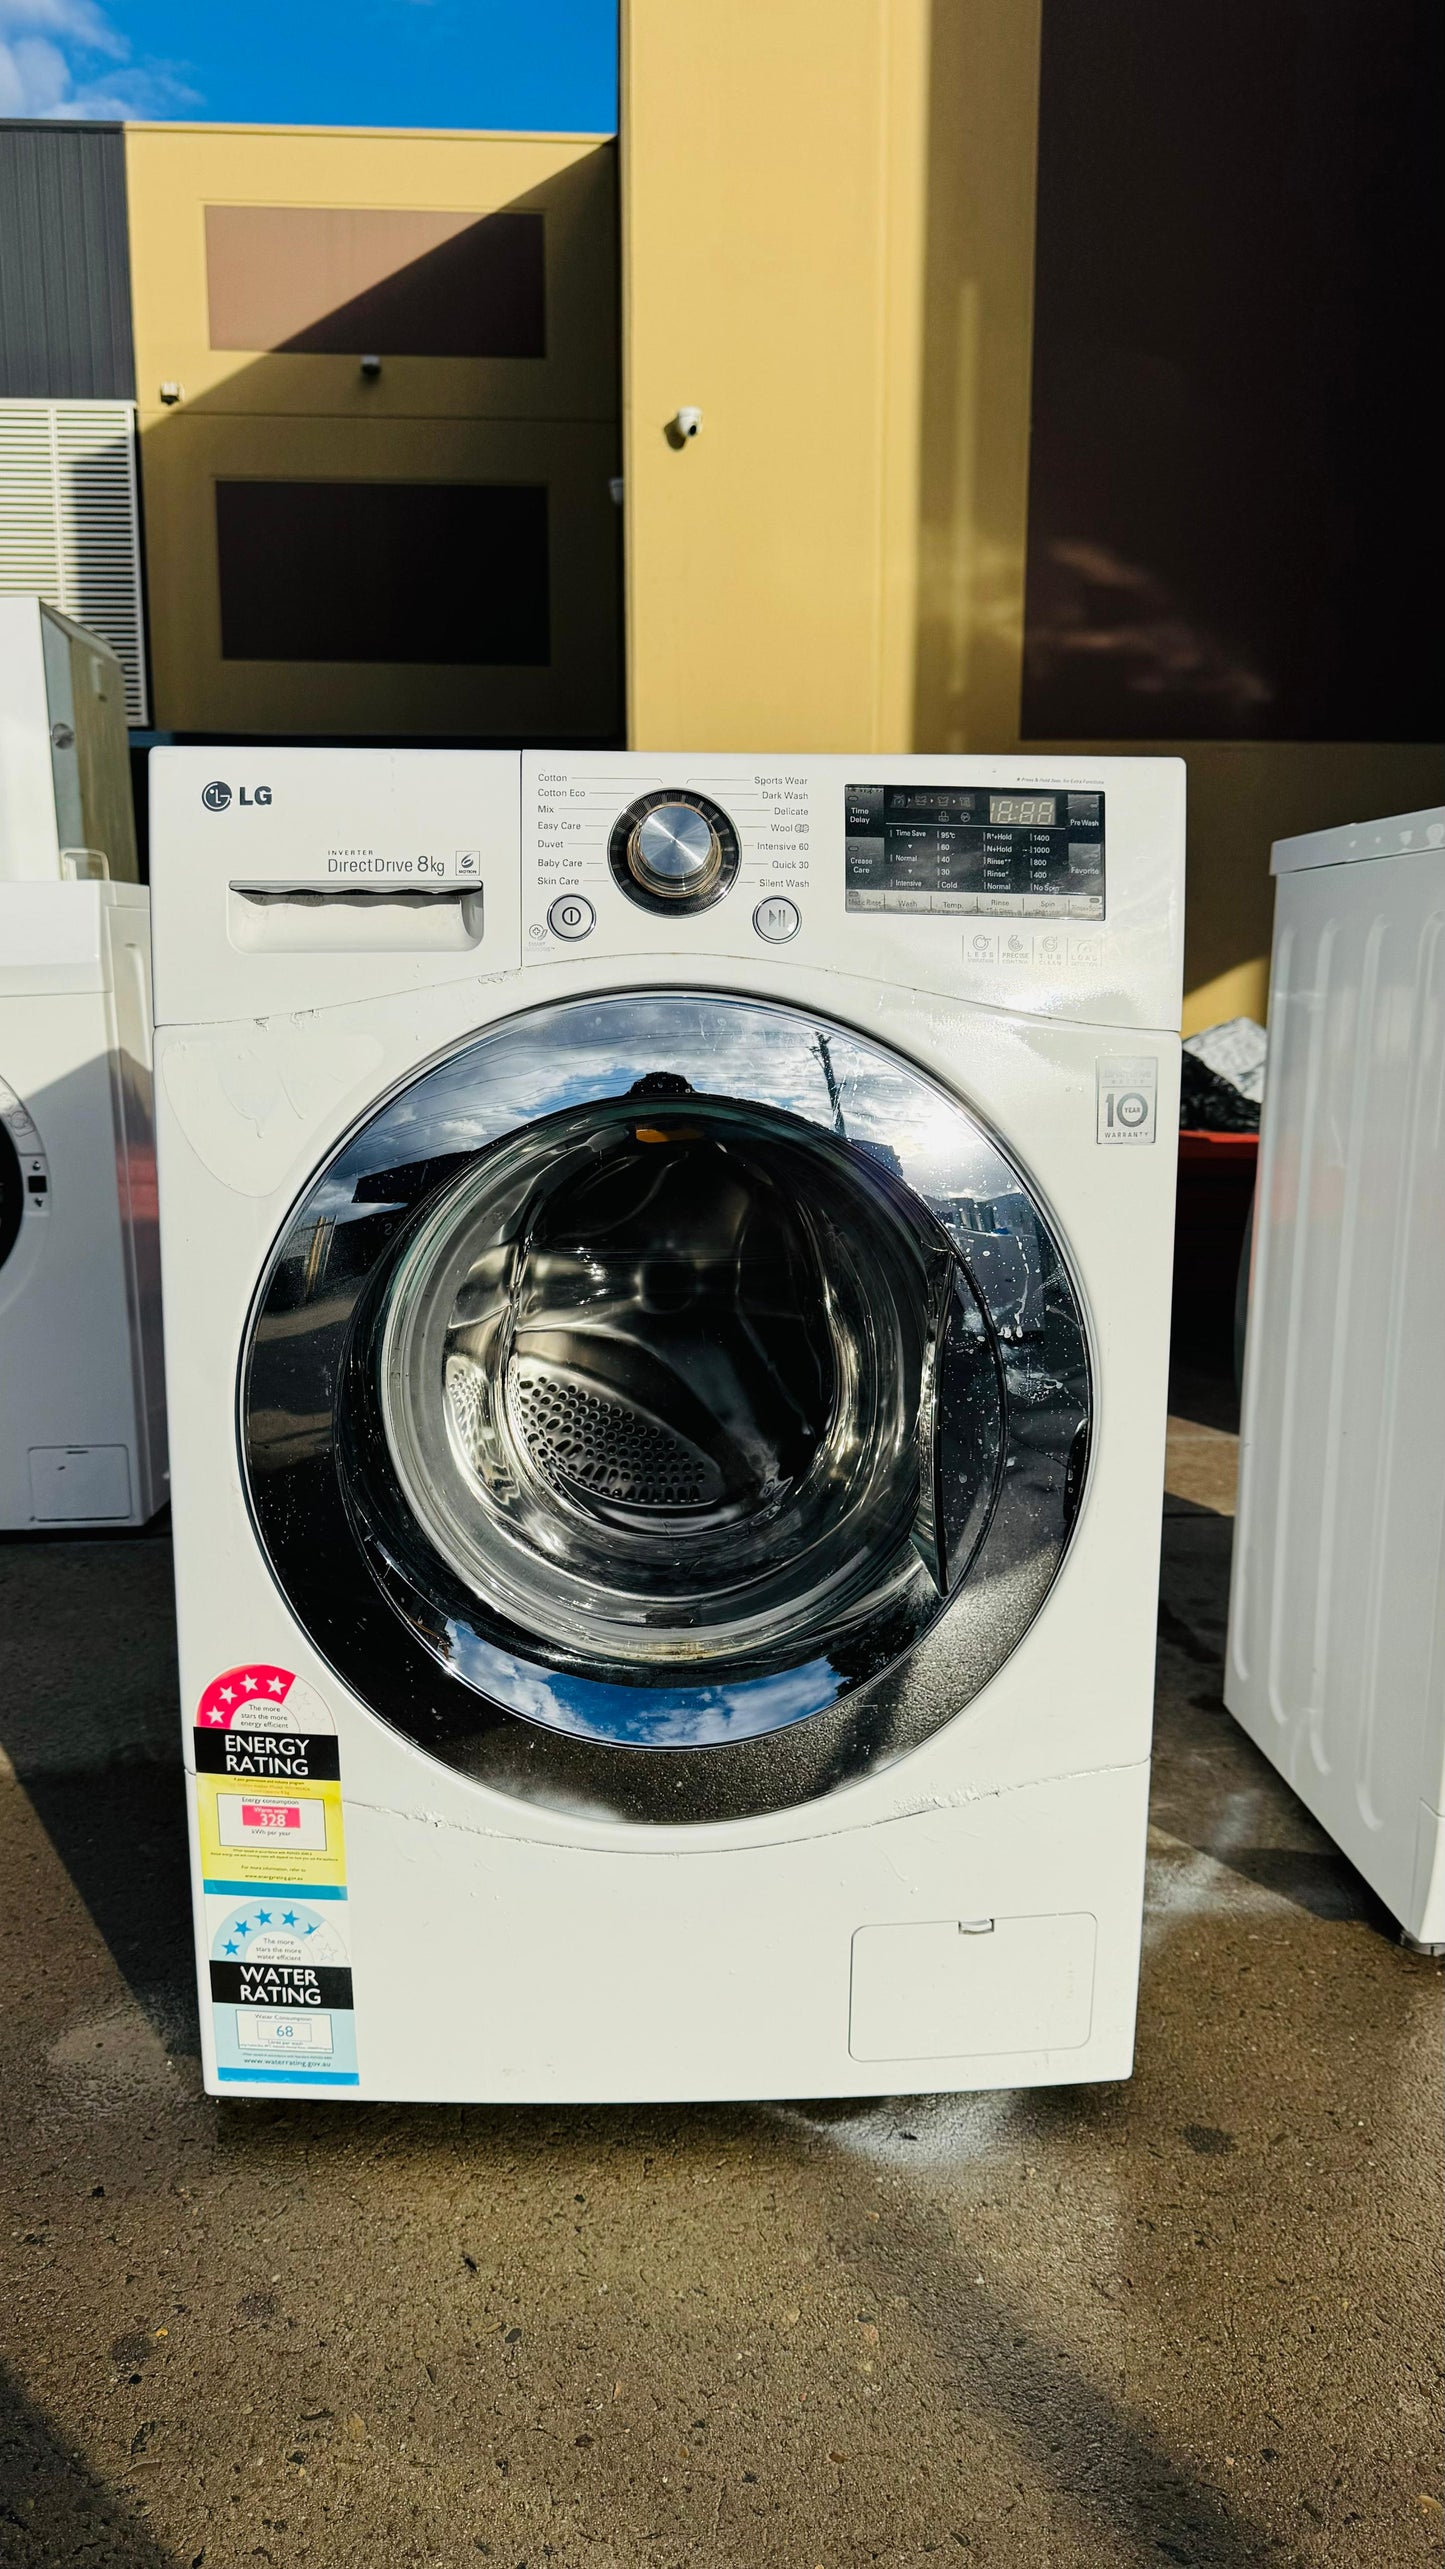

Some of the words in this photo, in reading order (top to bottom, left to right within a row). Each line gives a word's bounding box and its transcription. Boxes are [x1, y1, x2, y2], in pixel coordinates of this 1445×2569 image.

[537, 773, 568, 782] Cotton
[754, 776, 783, 787] Sports
[785, 776, 808, 785] Wear
[240, 786, 273, 806] LG
[537, 788, 568, 797] Cotton
[569, 788, 586, 798] Eco
[762, 791, 782, 800] Dark
[783, 791, 809, 800] Wash
[537, 805, 554, 813] Mix
[774, 807, 809, 815] Delicate
[851, 807, 869, 815] Time
[849, 816, 870, 824] Delay
[1081, 819, 1099, 827] Wash
[537, 821, 559, 831] Easy
[560, 821, 581, 830] Care
[770, 823, 793, 832] Wool
[896, 829, 911, 837] Time
[911, 830, 926, 838] Save
[1033, 834, 1050, 842] 1400
[537, 839, 564, 848] Duvet
[757, 842, 797, 851] Intensive
[798, 842, 810, 851] 60
[940, 843, 950, 851] 60
[987, 845, 1012, 853] N+Hold
[1033, 846, 1050, 854] 1000
[850, 857, 873, 865] Crease
[895, 854, 918, 862] Normal
[941, 856, 950, 864] 40
[537, 858, 560, 868] Baby
[562, 858, 583, 867] Care
[772, 860, 797, 869] Quick
[798, 861, 809, 869] 30
[1033, 859, 1047, 867] 800
[853, 866, 870, 874] Care
[941, 868, 950, 876] 30
[1070, 866, 1099, 876] Favorite
[1033, 871, 1047, 879] 400
[537, 876, 557, 885] Skin
[559, 876, 580, 885] Care
[759, 878, 784, 888] Silent
[785, 879, 810, 888] Wash
[895, 879, 922, 888] Intensive
[941, 881, 958, 889] Cold
[987, 882, 1011, 890] Normal
[1033, 883, 1044, 891] No
[898, 899, 918, 908] Wash
[943, 901, 964, 911] Temp.
[991, 899, 1010, 907] Rinse
[1040, 900, 1056, 910] Spin
[1105, 1092, 1149, 1128] 10
[263, 1721, 289, 1729] efficient
[224, 1734, 310, 1756] ENERGY
[225, 1754, 309, 1776] RATING
[241, 1796, 261, 1804] Energy
[254, 1806, 273, 1814] Warm
[260, 1813, 286, 1827] 328
[264, 1937, 275, 1945] The
[239, 1965, 319, 1986] WATER
[240, 1984, 322, 2005] RATING
[276, 2025, 294, 2038] 68
[243, 2058, 332, 2068] www.waterrating.gov.au
